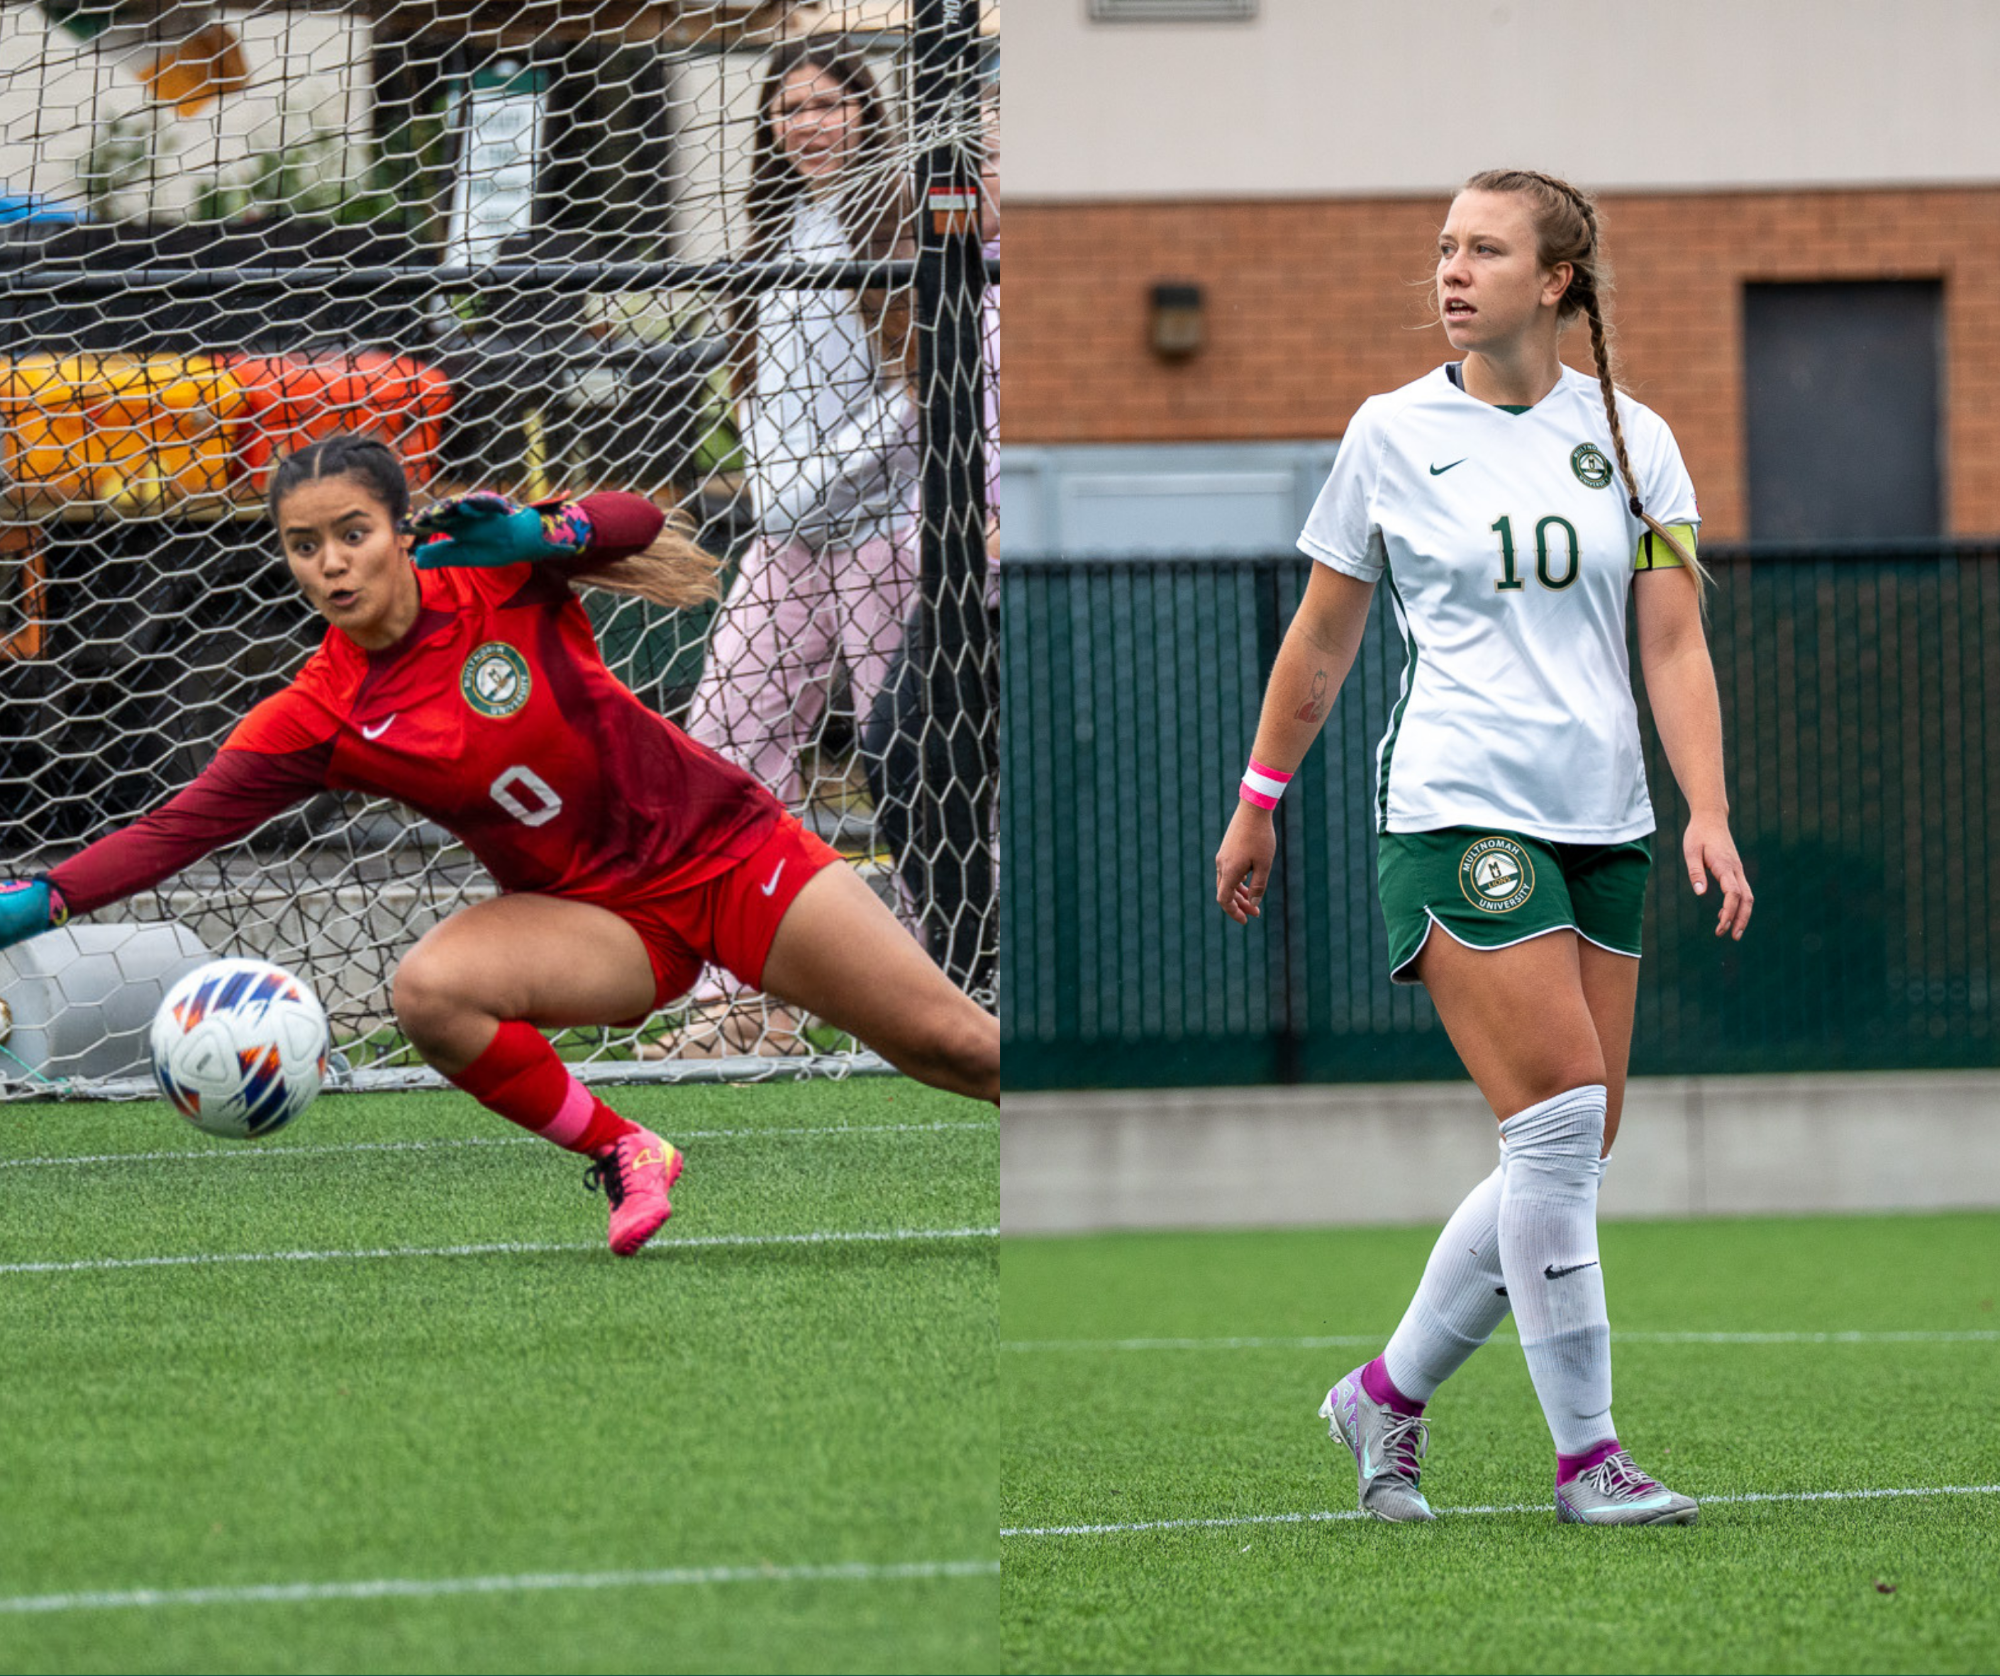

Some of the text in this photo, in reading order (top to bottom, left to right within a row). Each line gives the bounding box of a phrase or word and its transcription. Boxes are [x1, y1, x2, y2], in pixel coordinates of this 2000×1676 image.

[1489, 513, 1582, 593] 10
[489, 765, 563, 827] 0
[1463, 839, 1520, 872] MULTNOMAH
[1479, 883, 1531, 910] UNIVERSITY
[1488, 875, 1511, 889] LIONS
